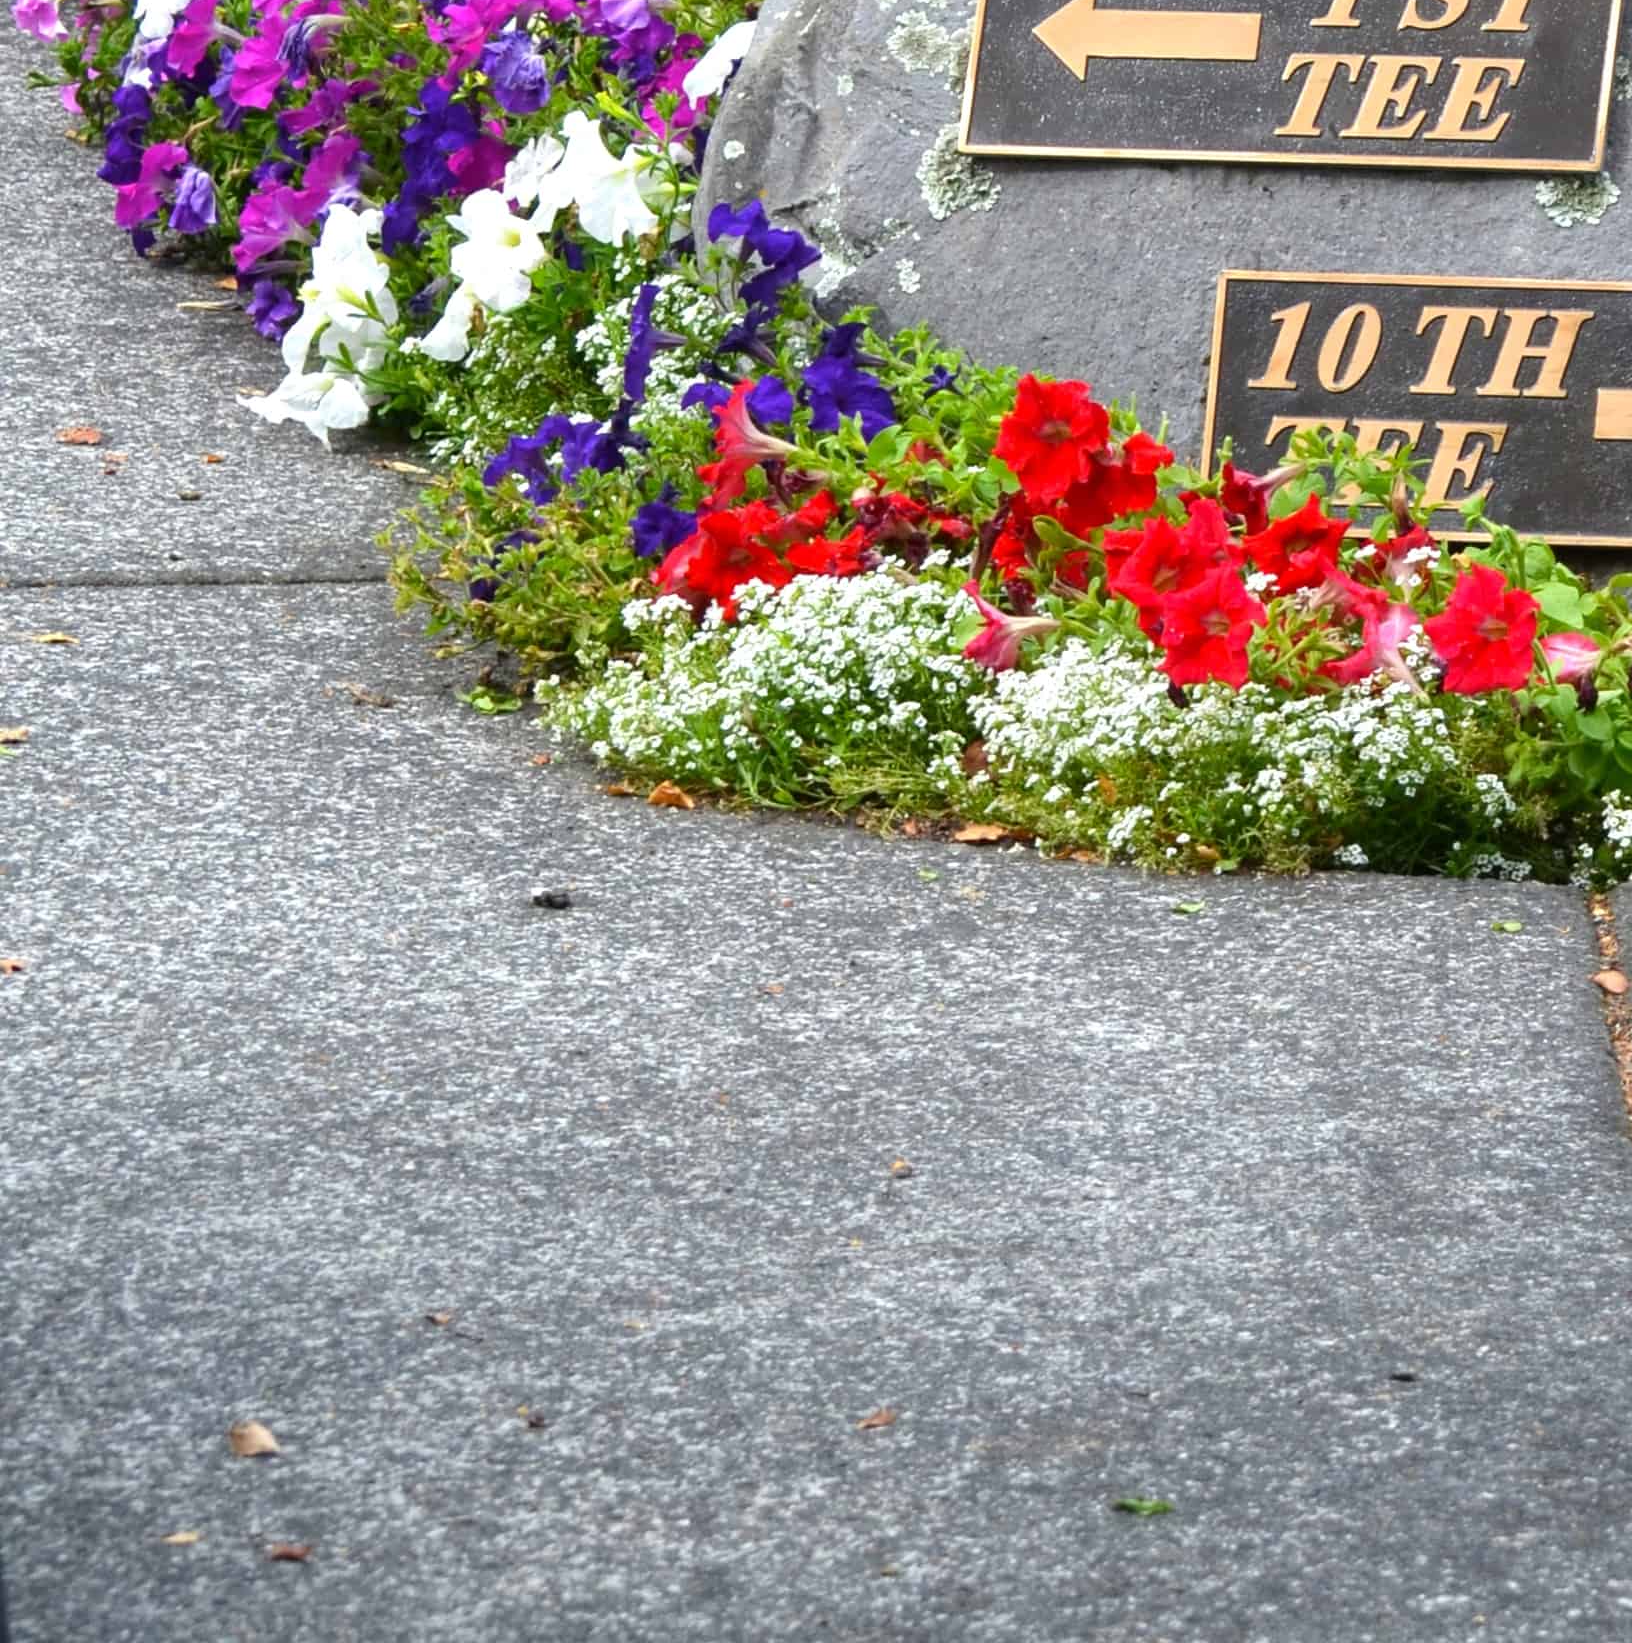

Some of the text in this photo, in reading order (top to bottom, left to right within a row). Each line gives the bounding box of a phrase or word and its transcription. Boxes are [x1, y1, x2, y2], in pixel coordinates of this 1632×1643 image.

[1273, 52, 1527, 142] TEE
[1246, 301, 1596, 399] 10 TH
